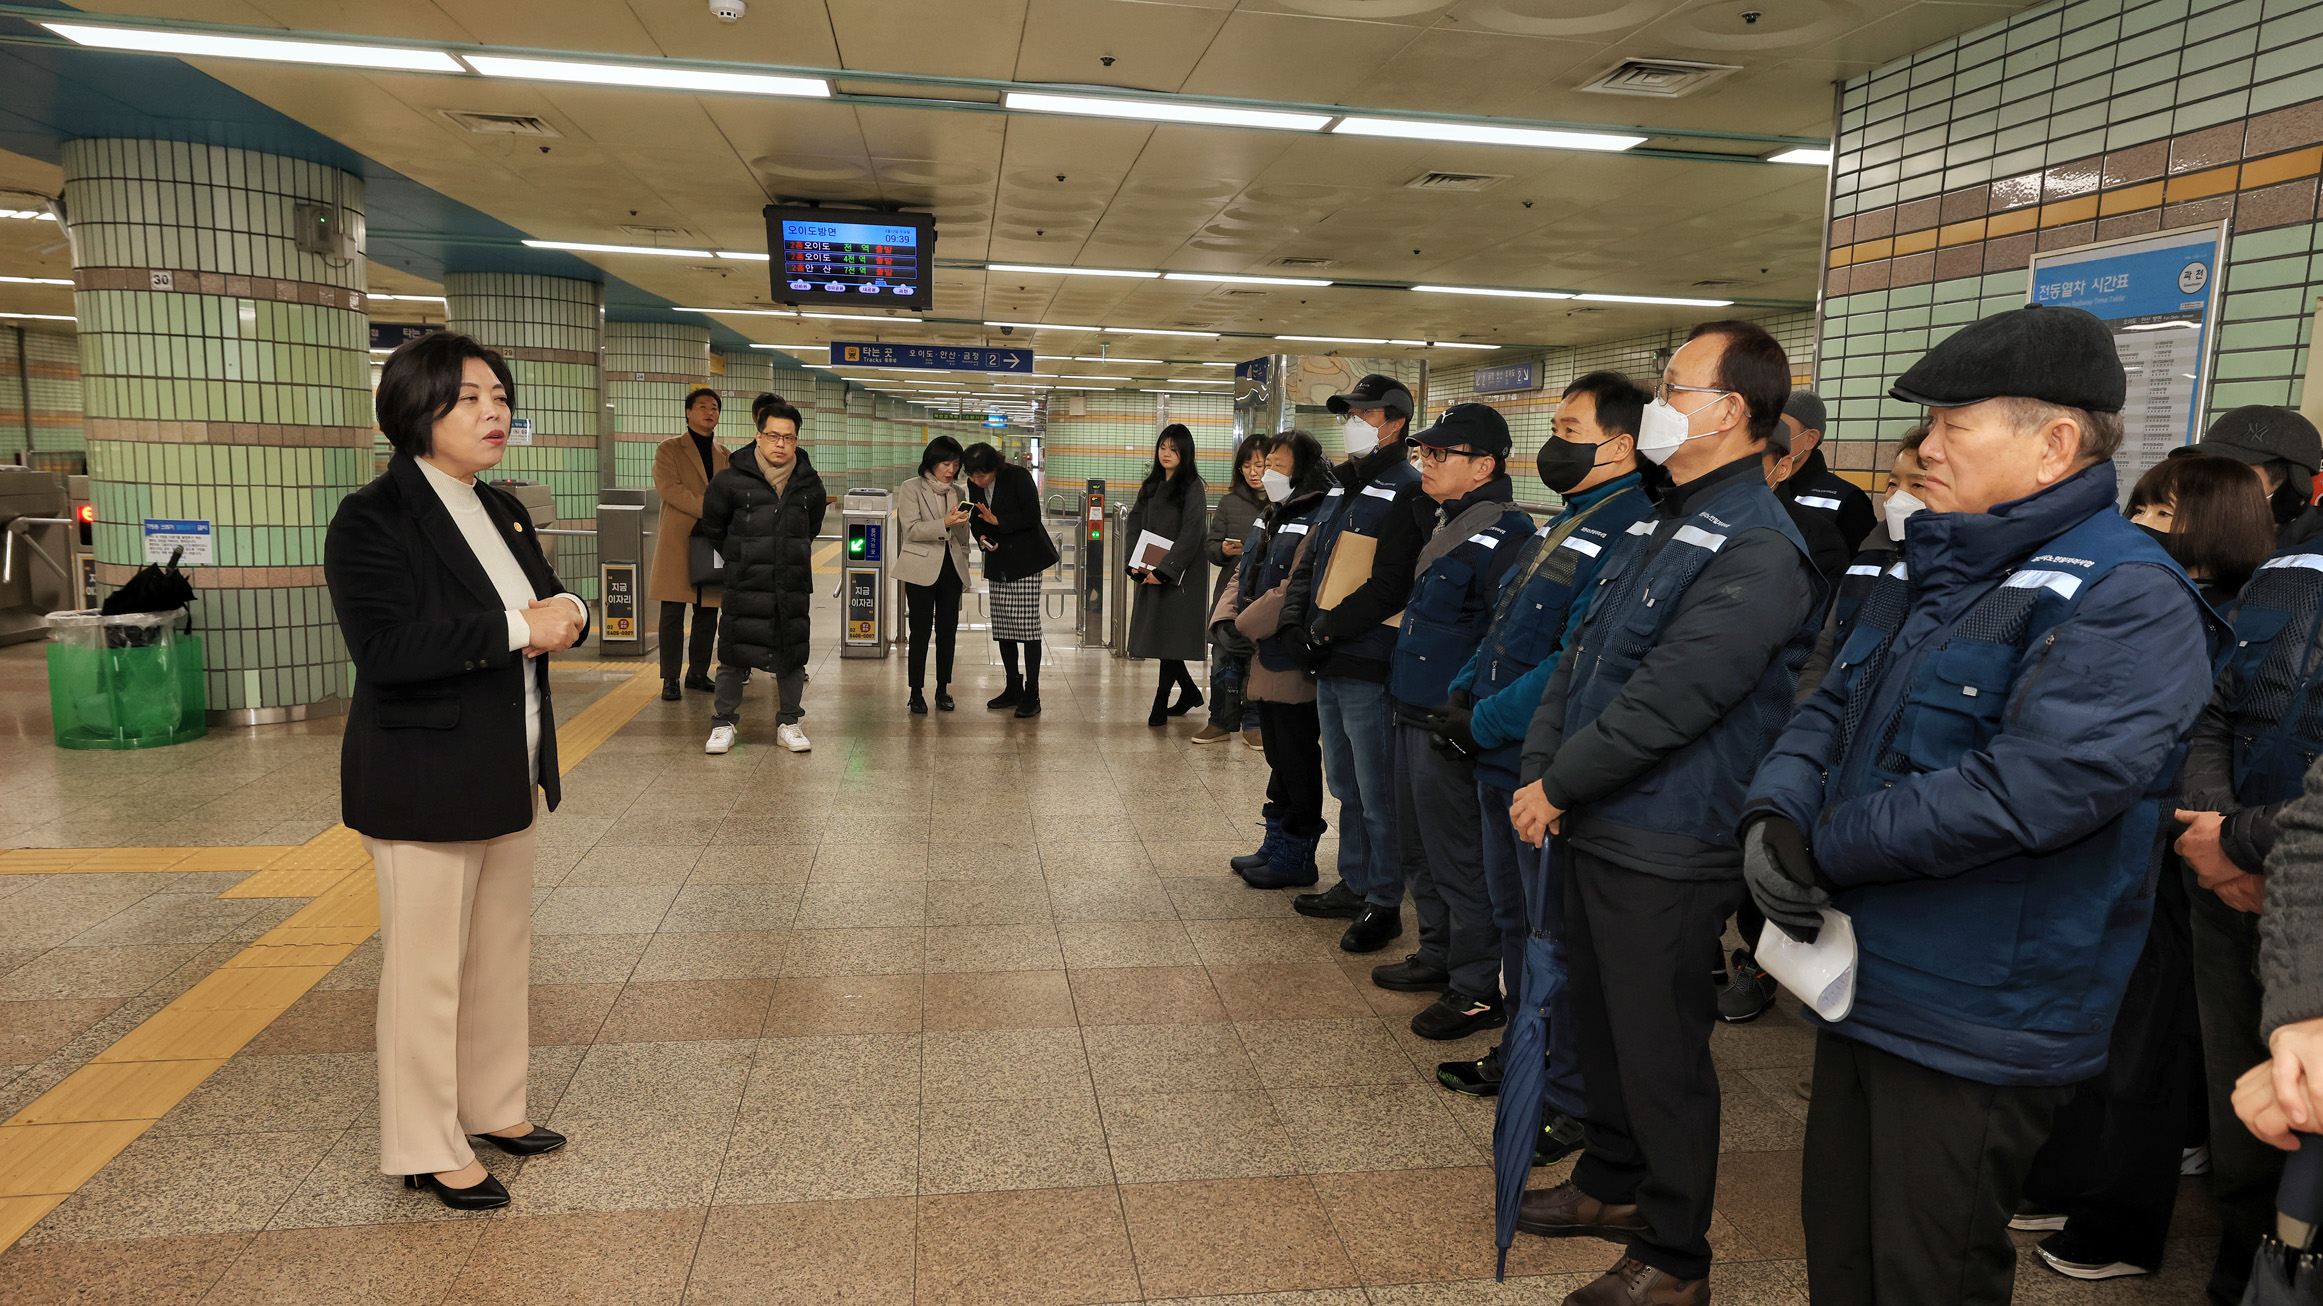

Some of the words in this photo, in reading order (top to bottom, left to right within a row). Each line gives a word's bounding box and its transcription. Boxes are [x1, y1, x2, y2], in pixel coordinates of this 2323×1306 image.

[788, 226, 836, 236] 오이도방면
[886, 234, 909, 243] 09:39
[804, 242, 830, 250] 오이도
[876, 245, 893, 254] 출발
[805, 253, 831, 262] 오이도
[876, 256, 893, 265] 출발
[876, 268, 893, 276] 출발
[2184, 269, 2204, 280] 과천
[154, 274, 169, 285] 30
[2039, 279, 2086, 300] 전동열차
[2092, 274, 2129, 294] 시간표
[2072, 299, 2092, 307] Railway
[863, 347, 880, 357] 타는
[885, 348, 893, 358] 곳
[909, 350, 933, 358] 오이도
[940, 351, 956, 360] 안산
[964, 352, 979, 360] 금정
[989, 355, 996, 365] 2
[612, 583, 627, 592] 지금
[855, 587, 870, 596] 지금
[608, 595, 631, 604] 이자리
[852, 598, 873, 608] 이자리
